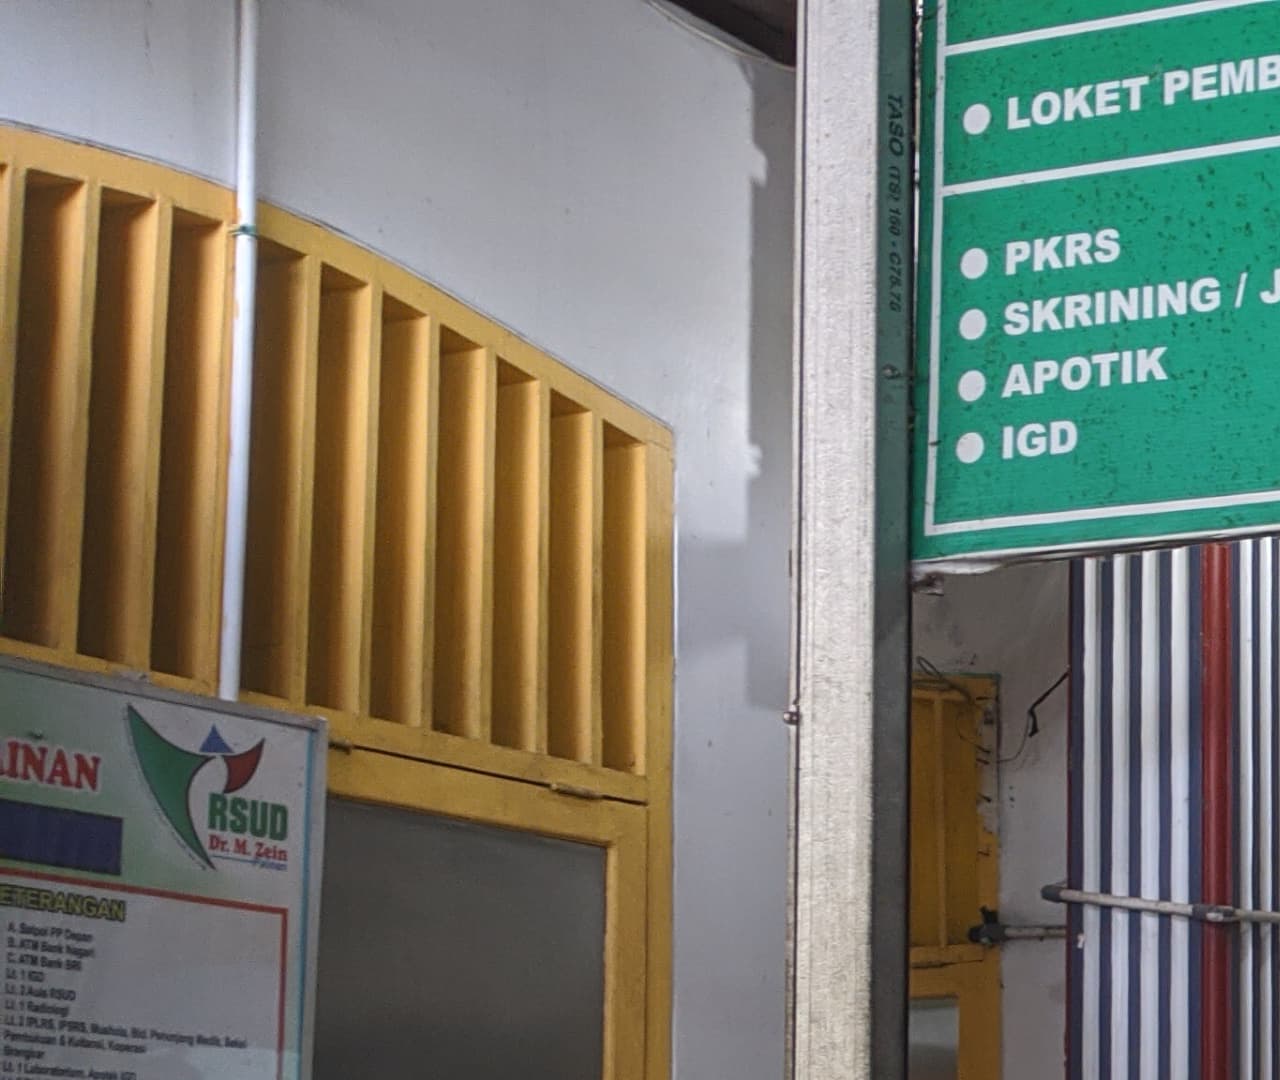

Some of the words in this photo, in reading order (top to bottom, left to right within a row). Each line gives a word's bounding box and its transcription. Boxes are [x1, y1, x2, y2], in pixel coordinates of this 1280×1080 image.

[887, 95, 904, 156] TASO
[1007, 76, 1149, 130] LOKET
[1004, 228, 1121, 275] PKRS
[1003, 277, 1221, 336] SKRINING
[1234, 273, 1248, 308] /
[1001, 346, 1168, 398] APOTIK
[1002, 420, 1078, 459] IGD
[208, 793, 288, 841] RSUD
[208, 835, 230, 853] Dr.
[233, 838, 251, 856] M.
[254, 842, 288, 862] Zein
